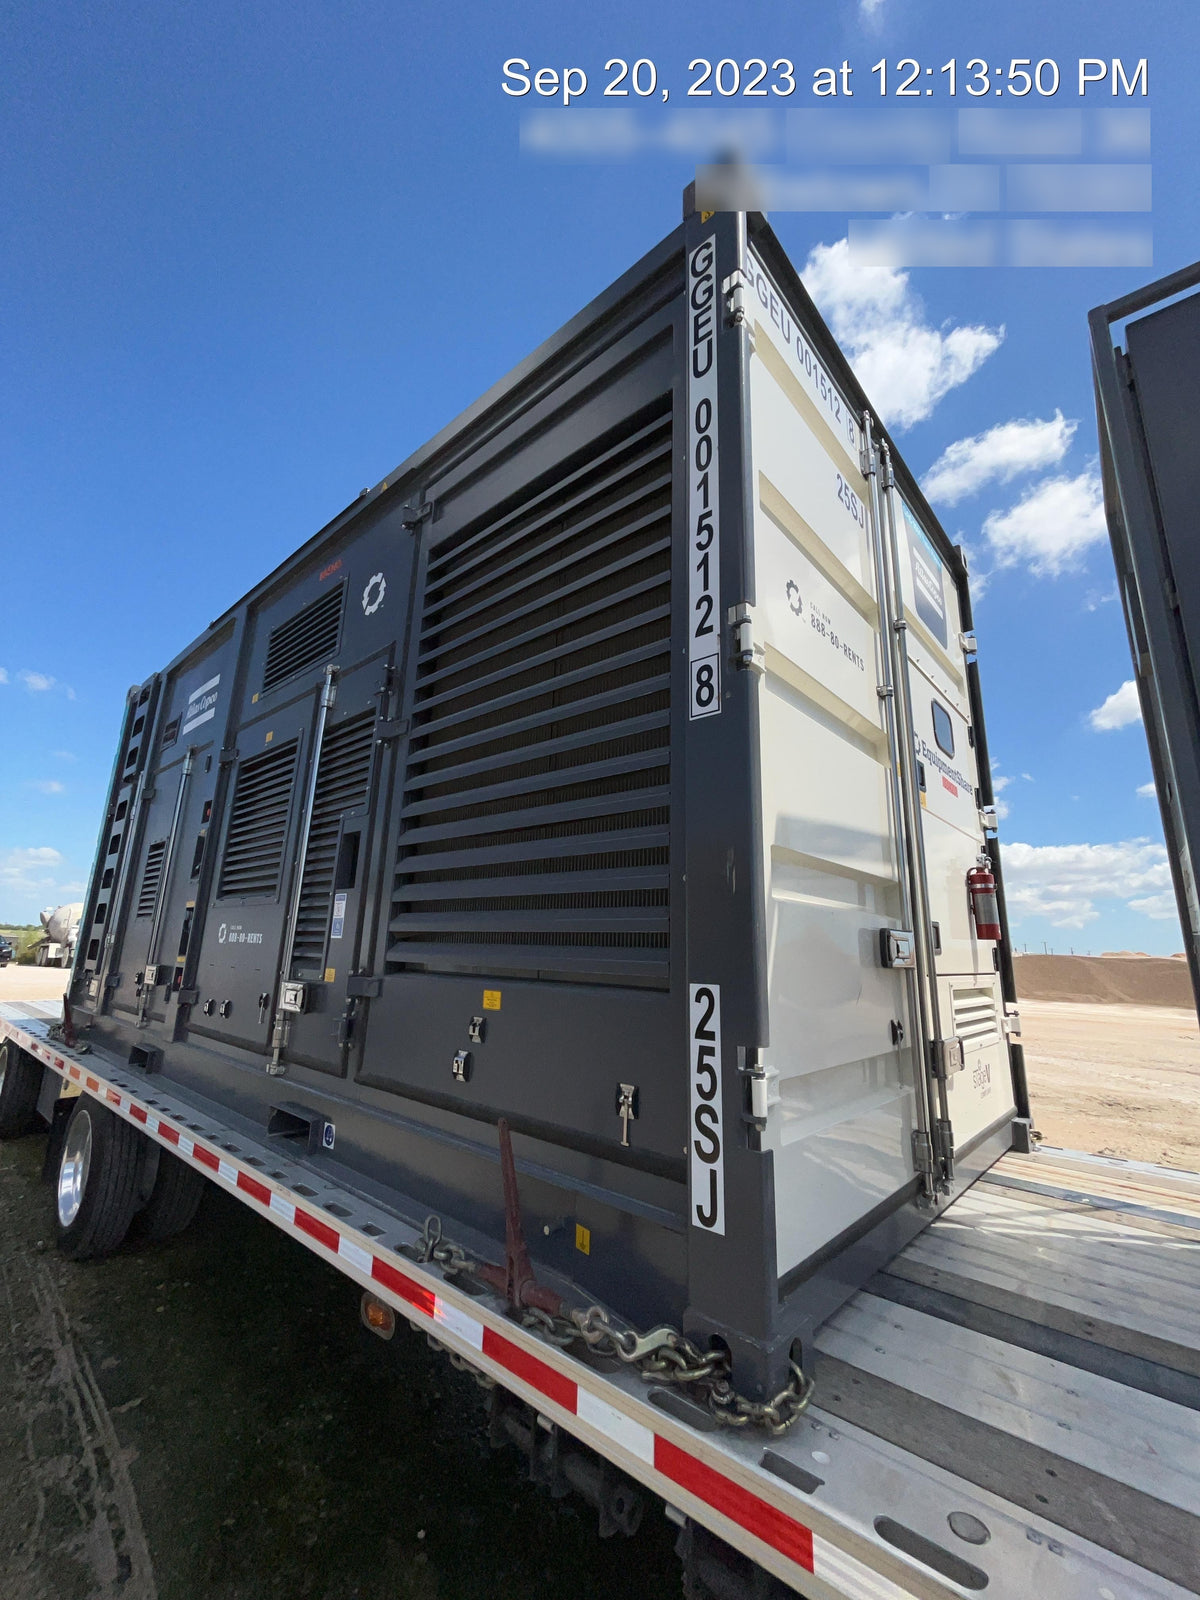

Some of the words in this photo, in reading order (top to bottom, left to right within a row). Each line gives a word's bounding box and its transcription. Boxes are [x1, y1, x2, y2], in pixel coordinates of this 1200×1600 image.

[690, 240, 714, 379] GGEU
[796, 335, 842, 425] 001512
[694, 397, 714, 638] 001512
[836, 472, 864, 529] 25SJ
[810, 613, 865, 672] 888-80-RENTS
[695, 663, 715, 708] 8
[921, 739, 973, 796] EquipmentShare
[694, 987, 721, 1229] 25SJ
